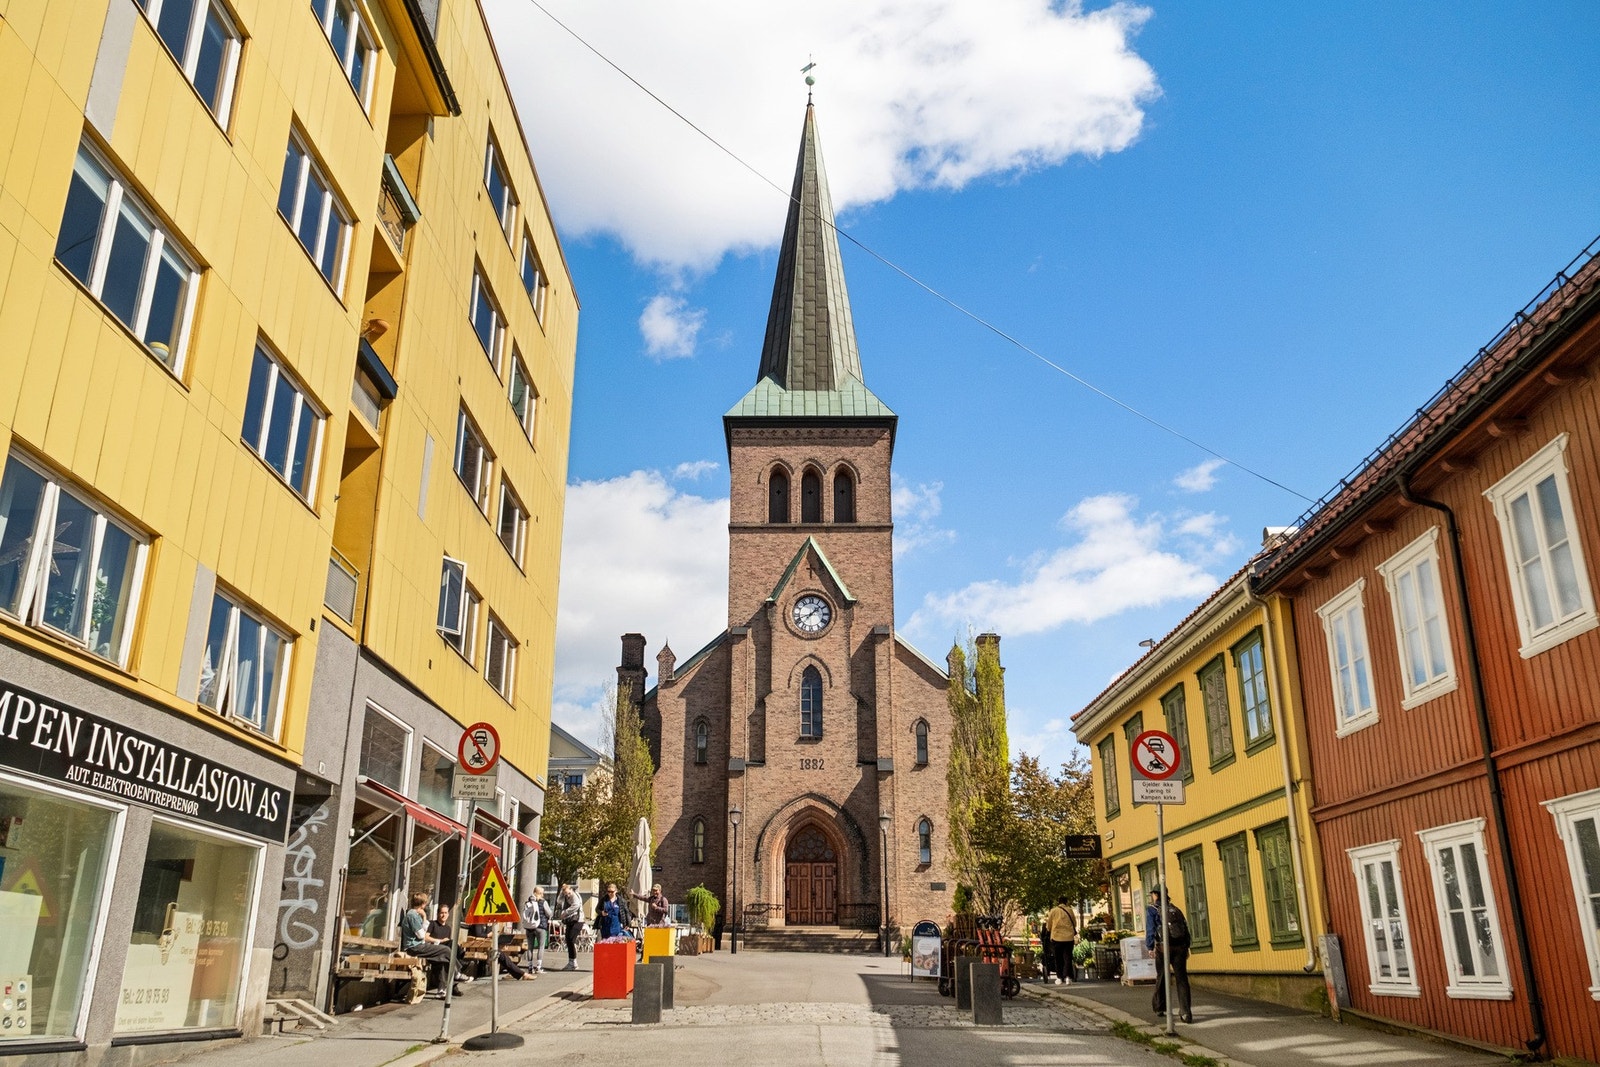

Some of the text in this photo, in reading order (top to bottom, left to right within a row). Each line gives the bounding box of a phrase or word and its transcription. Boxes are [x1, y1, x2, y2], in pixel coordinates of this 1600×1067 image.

[85, 722, 256, 814] INSTALLASJON
[255, 787, 281, 821] AS
[800, 758, 825, 770] 1882
[65, 764, 199, 816] AUT. ELEKTROENTREPRENØR
[135, 988, 144, 1004] 22
